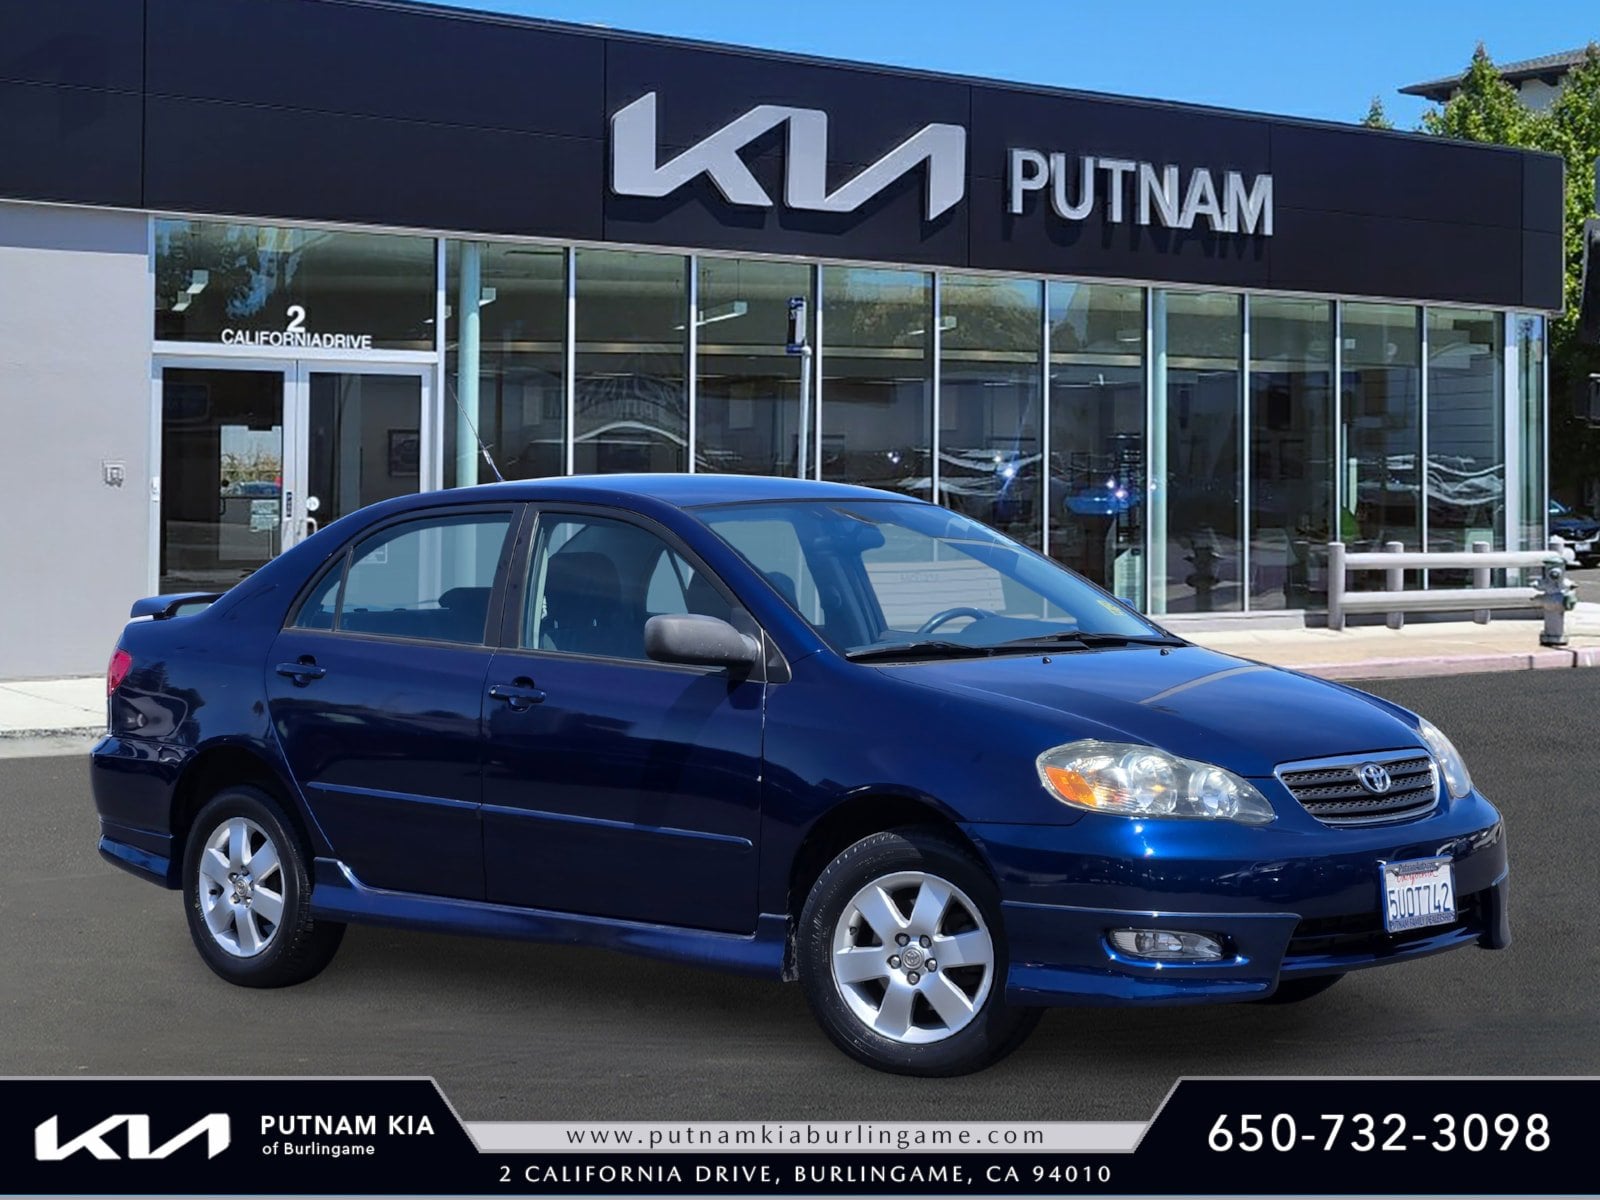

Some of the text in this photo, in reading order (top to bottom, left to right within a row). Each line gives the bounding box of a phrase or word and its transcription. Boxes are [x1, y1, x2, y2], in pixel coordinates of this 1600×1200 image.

[610, 91, 966, 221] KIA
[1007, 147, 1274, 236] PUTNAM
[286, 305, 306, 333] 2
